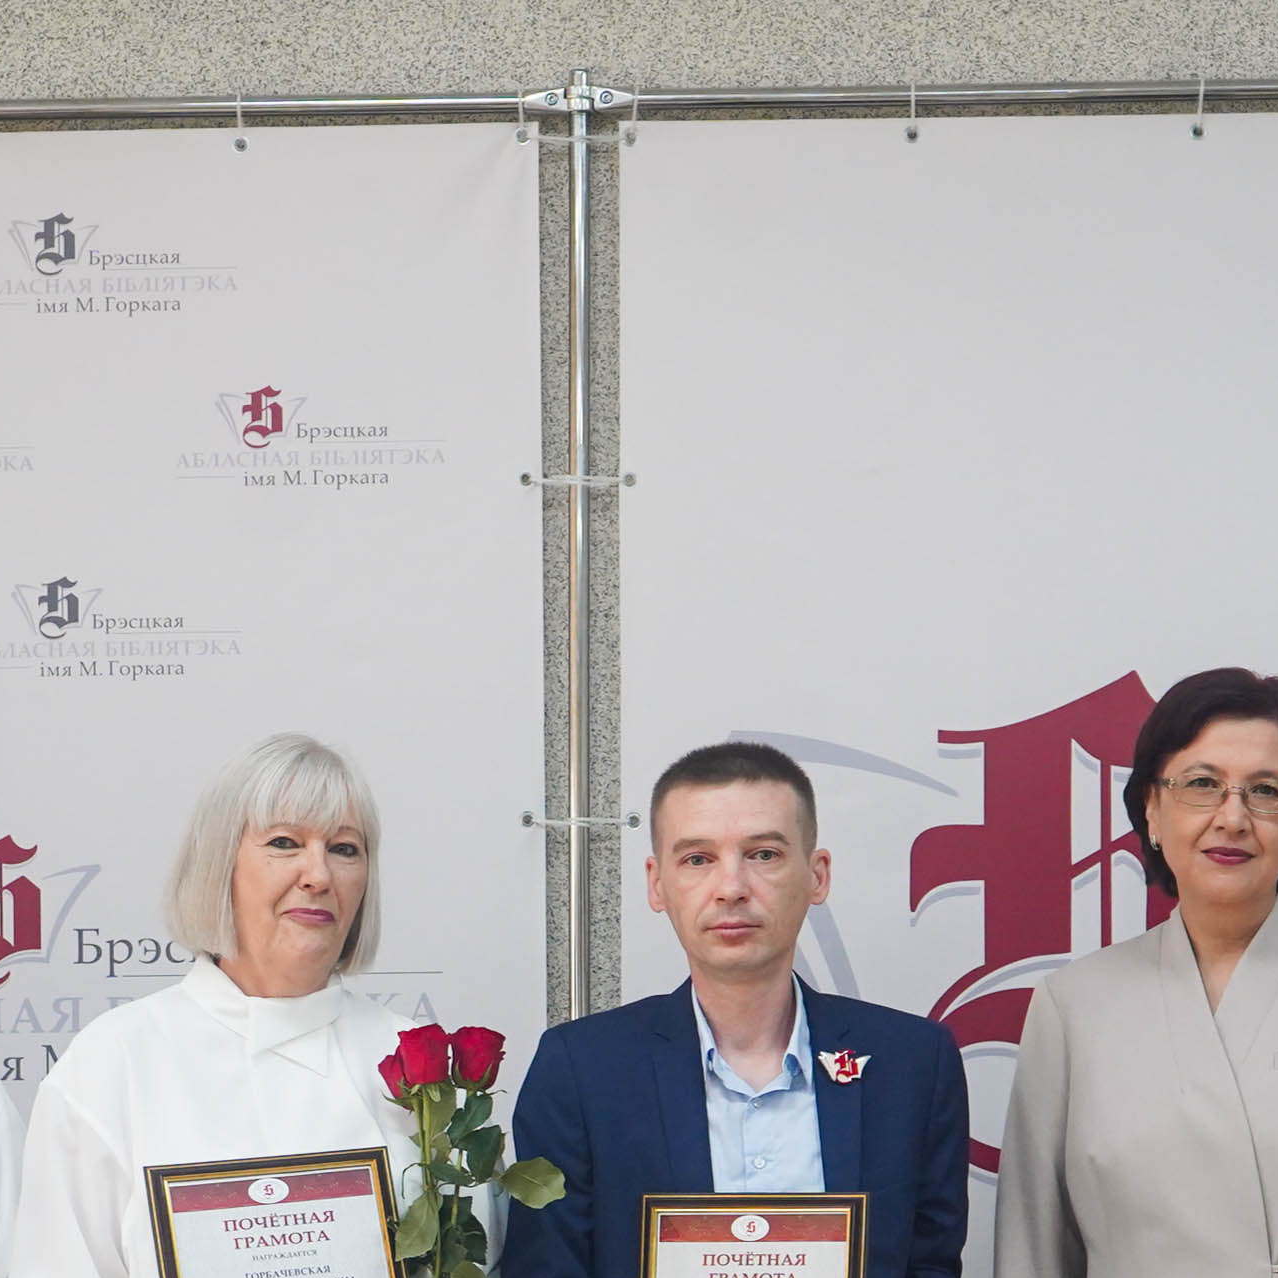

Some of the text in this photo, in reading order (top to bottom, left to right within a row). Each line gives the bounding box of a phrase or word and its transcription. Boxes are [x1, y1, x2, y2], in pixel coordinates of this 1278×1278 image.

[89, 250, 180, 270] Брэсцкая
[102, 275, 238, 294] БІБЛІЯТЭКА
[37, 298, 68, 314] імя
[105, 297, 181, 317] Горкага
[296, 423, 388, 443] Брэсцкая
[176, 448, 446, 469] АБЛАСНАЯ БІБЛІЯТЭКА
[244, 472, 275, 487] імя
[313, 470, 389, 490] Горкага
[92, 614, 184, 634] Брэсцкая
[105, 639, 242, 657] БІБЛІЯТЭКА
[40, 662, 72, 677] імя
[109, 660, 185, 681] Горкага
[224, 1210, 335, 1232] ПОЧЁТНАЯ
[233, 1230, 330, 1250] ГРАМОТА
[702, 1251, 807, 1266] ПОЧЁТНАЯ
